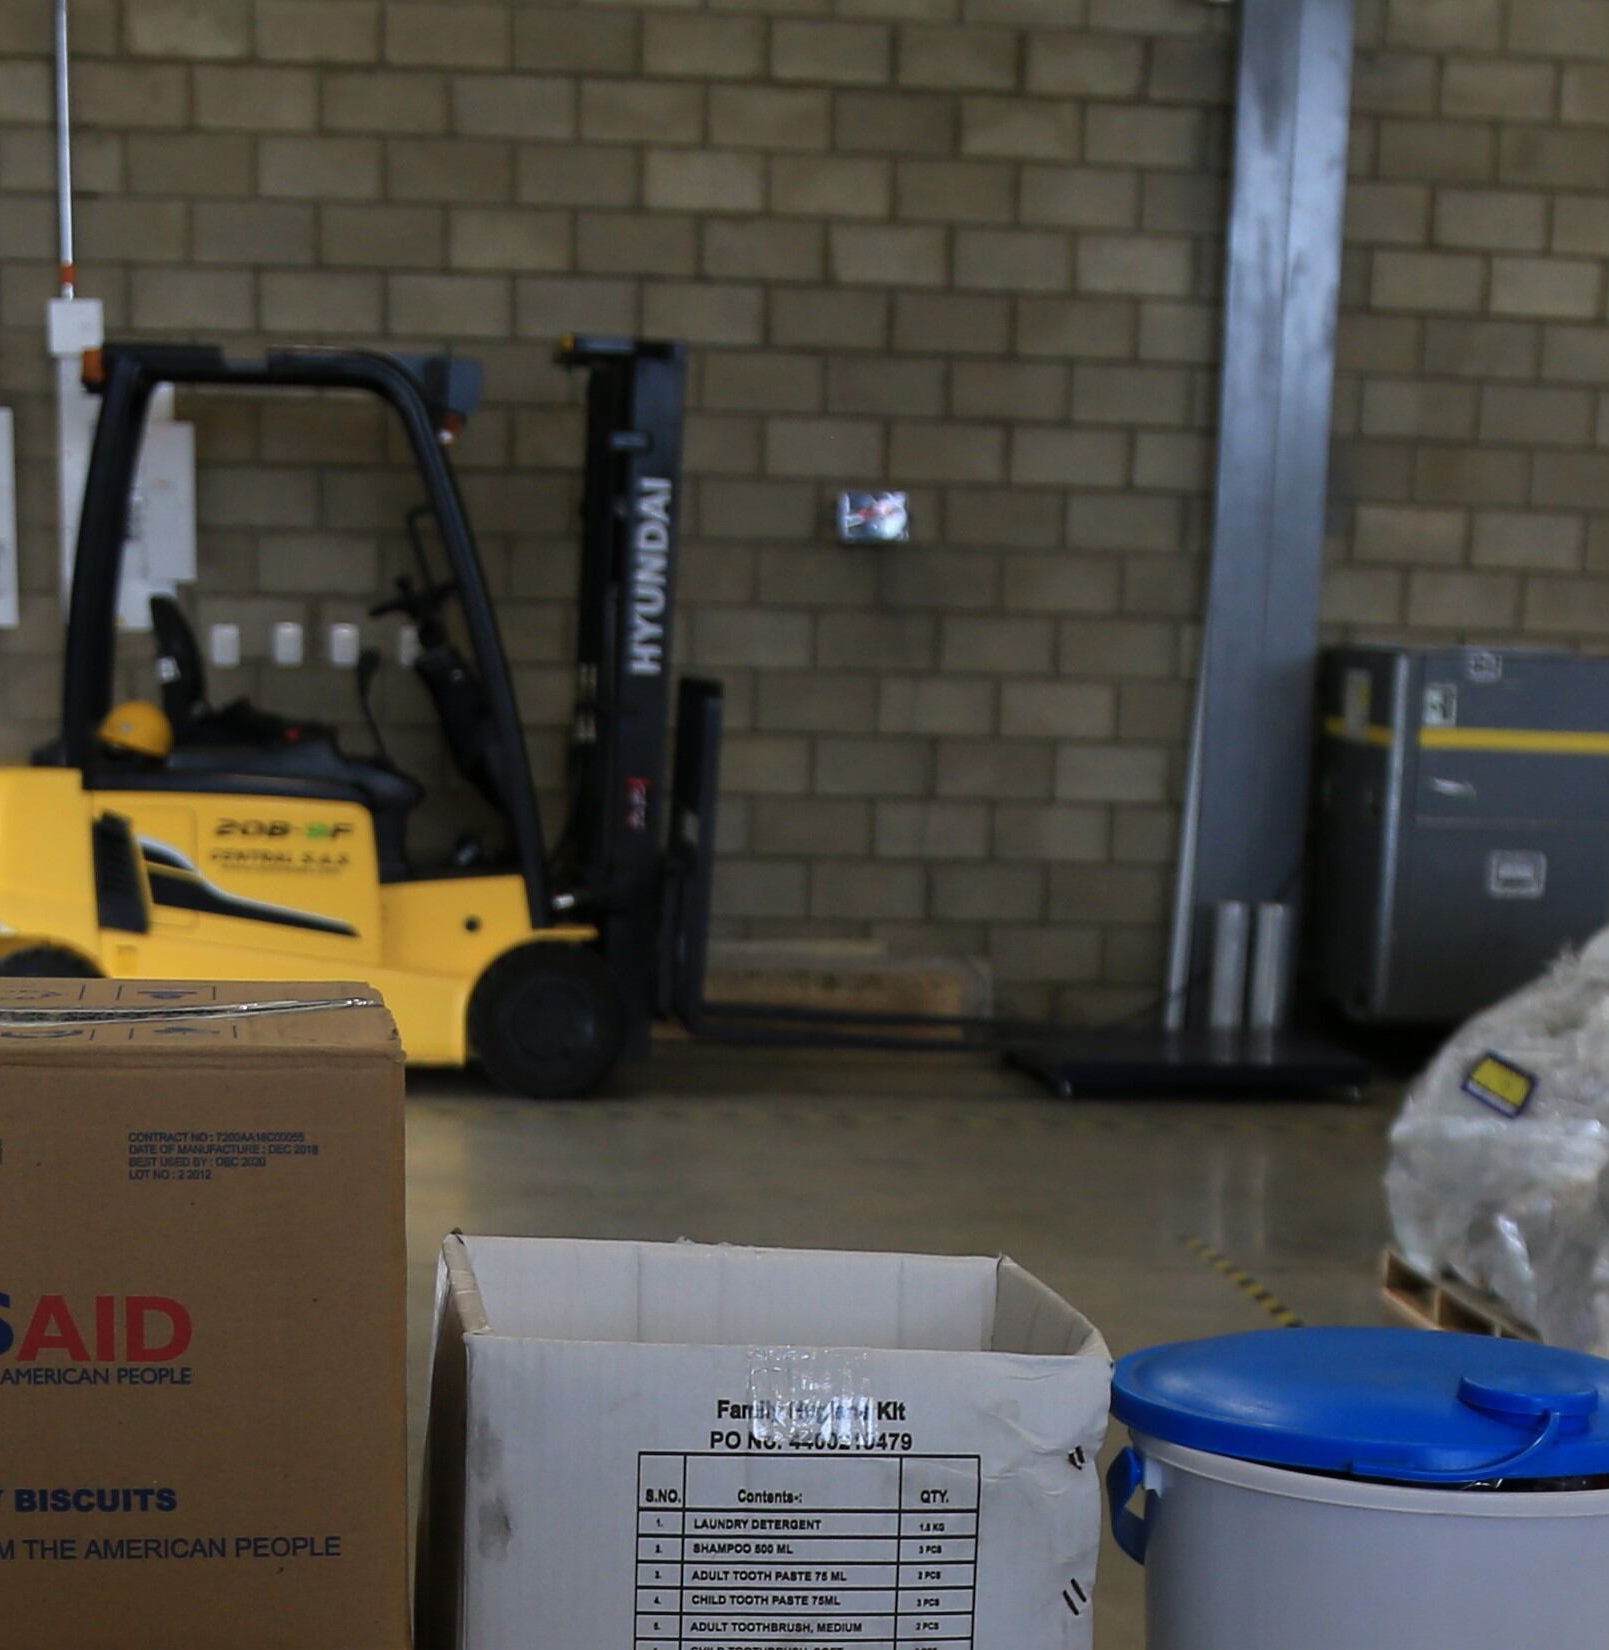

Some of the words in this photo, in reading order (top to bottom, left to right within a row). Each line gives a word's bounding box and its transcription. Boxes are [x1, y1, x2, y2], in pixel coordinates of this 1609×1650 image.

[630, 478, 670, 675] HYUNDAI
[116, 1366, 191, 1385] PEOPLE
[14, 1487, 177, 1512] BISCUITS
[645, 1489, 681, 1503] S.NO.
[921, 1490, 950, 1503] QTY.
[693, 1518, 749, 1530] LAUNDRY
[751, 1518, 822, 1530] DETERGENT
[21, 1538, 77, 1560] THE
[83, 1537, 226, 1560] AMERICAN
[234, 1535, 341, 1558] PEOPLE
[692, 1543, 751, 1554] SHAMPOO
[754, 1543, 773, 1554] 500
[776, 1543, 793, 1554] ML
[691, 1570, 730, 1581] ADULT
[732, 1570, 772, 1581] TOOTH
[774, 1570, 812, 1581] PASTE
[814, 1570, 828, 1581] 75
[830, 1570, 847, 1581] ML
